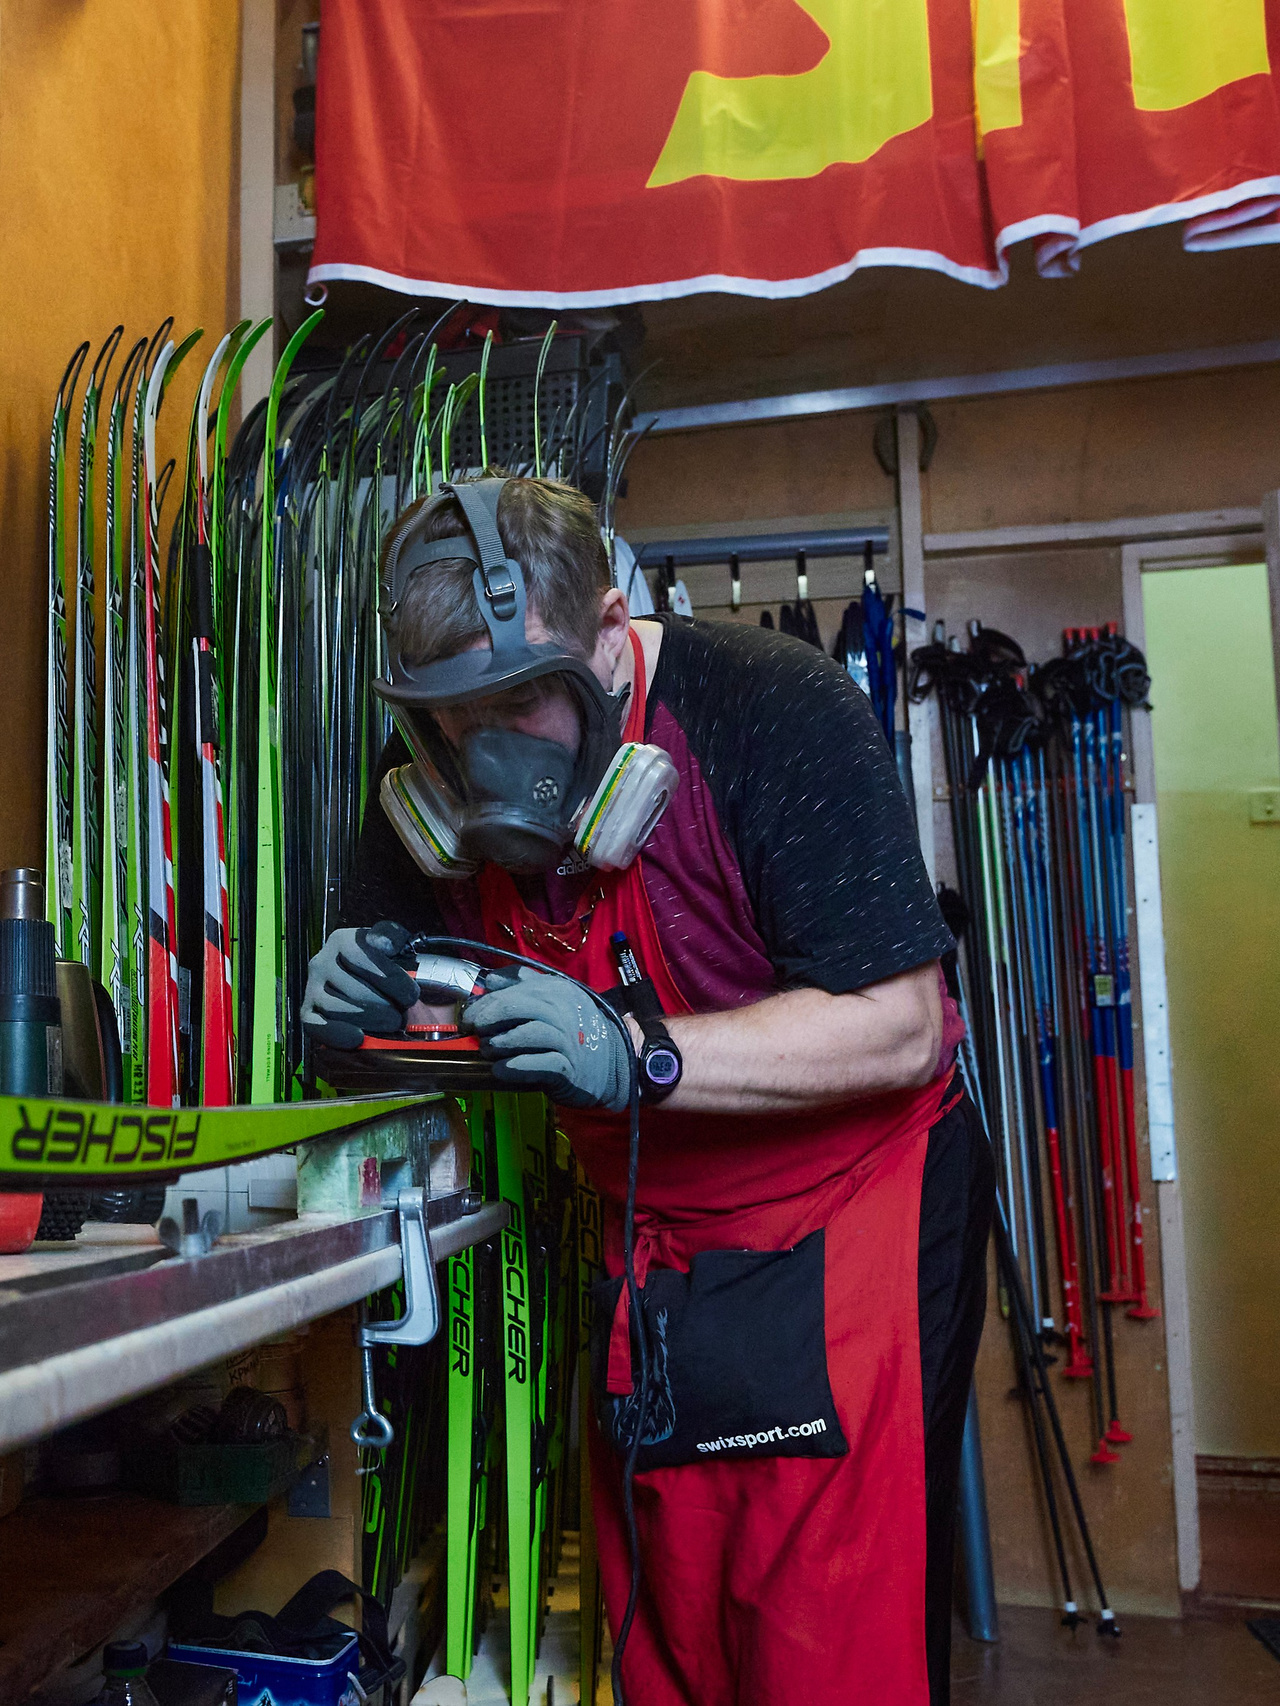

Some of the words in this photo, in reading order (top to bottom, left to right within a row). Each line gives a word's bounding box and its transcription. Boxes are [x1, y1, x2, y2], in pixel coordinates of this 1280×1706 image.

[556, 860, 590, 876] adida
[12, 1104, 201, 1164] FISCHER
[452, 1249, 471, 1378] CHER
[503, 1196, 527, 1385] FISCHER
[696, 1418, 827, 1453] swixsport.com
